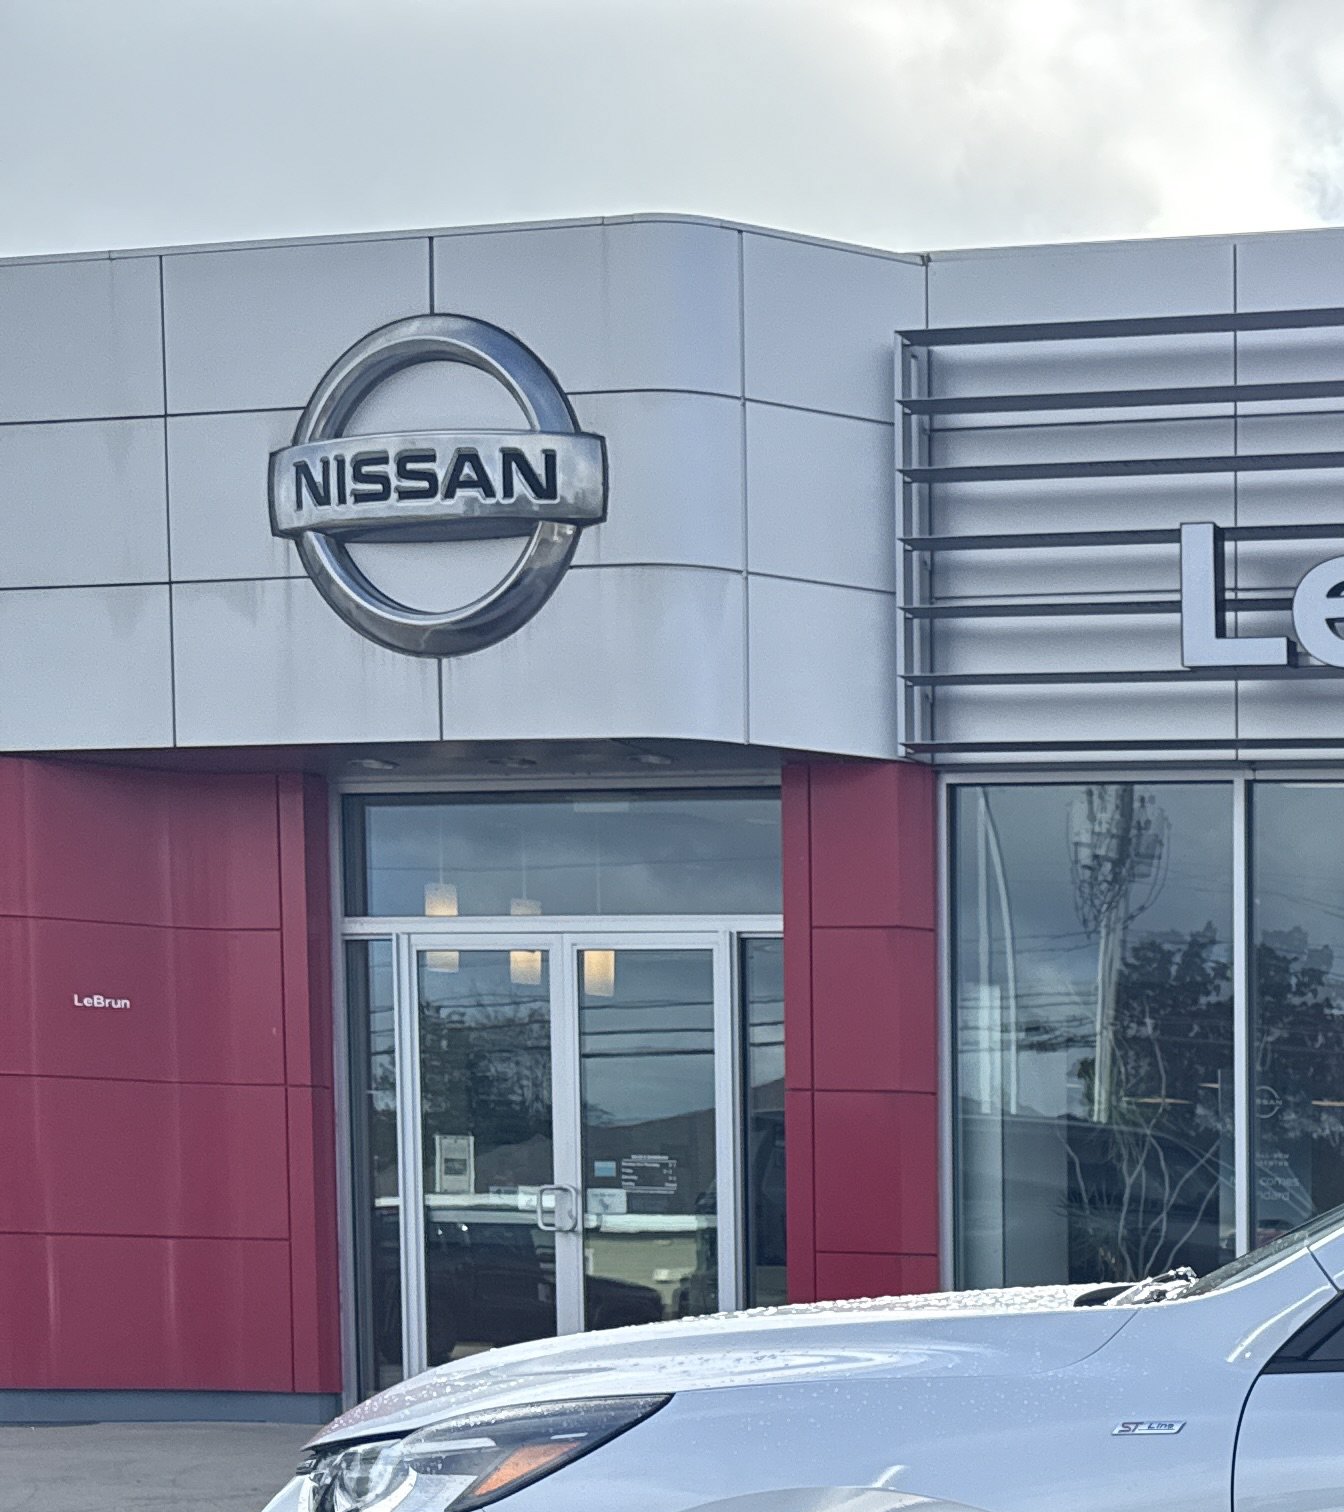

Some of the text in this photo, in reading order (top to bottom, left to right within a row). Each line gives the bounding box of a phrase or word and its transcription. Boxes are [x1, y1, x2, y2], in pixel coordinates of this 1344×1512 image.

[294, 447, 558, 512] NISSAN
[74, 994, 131, 1009] LeBrun
[1118, 1421, 1175, 1433] ST Line
